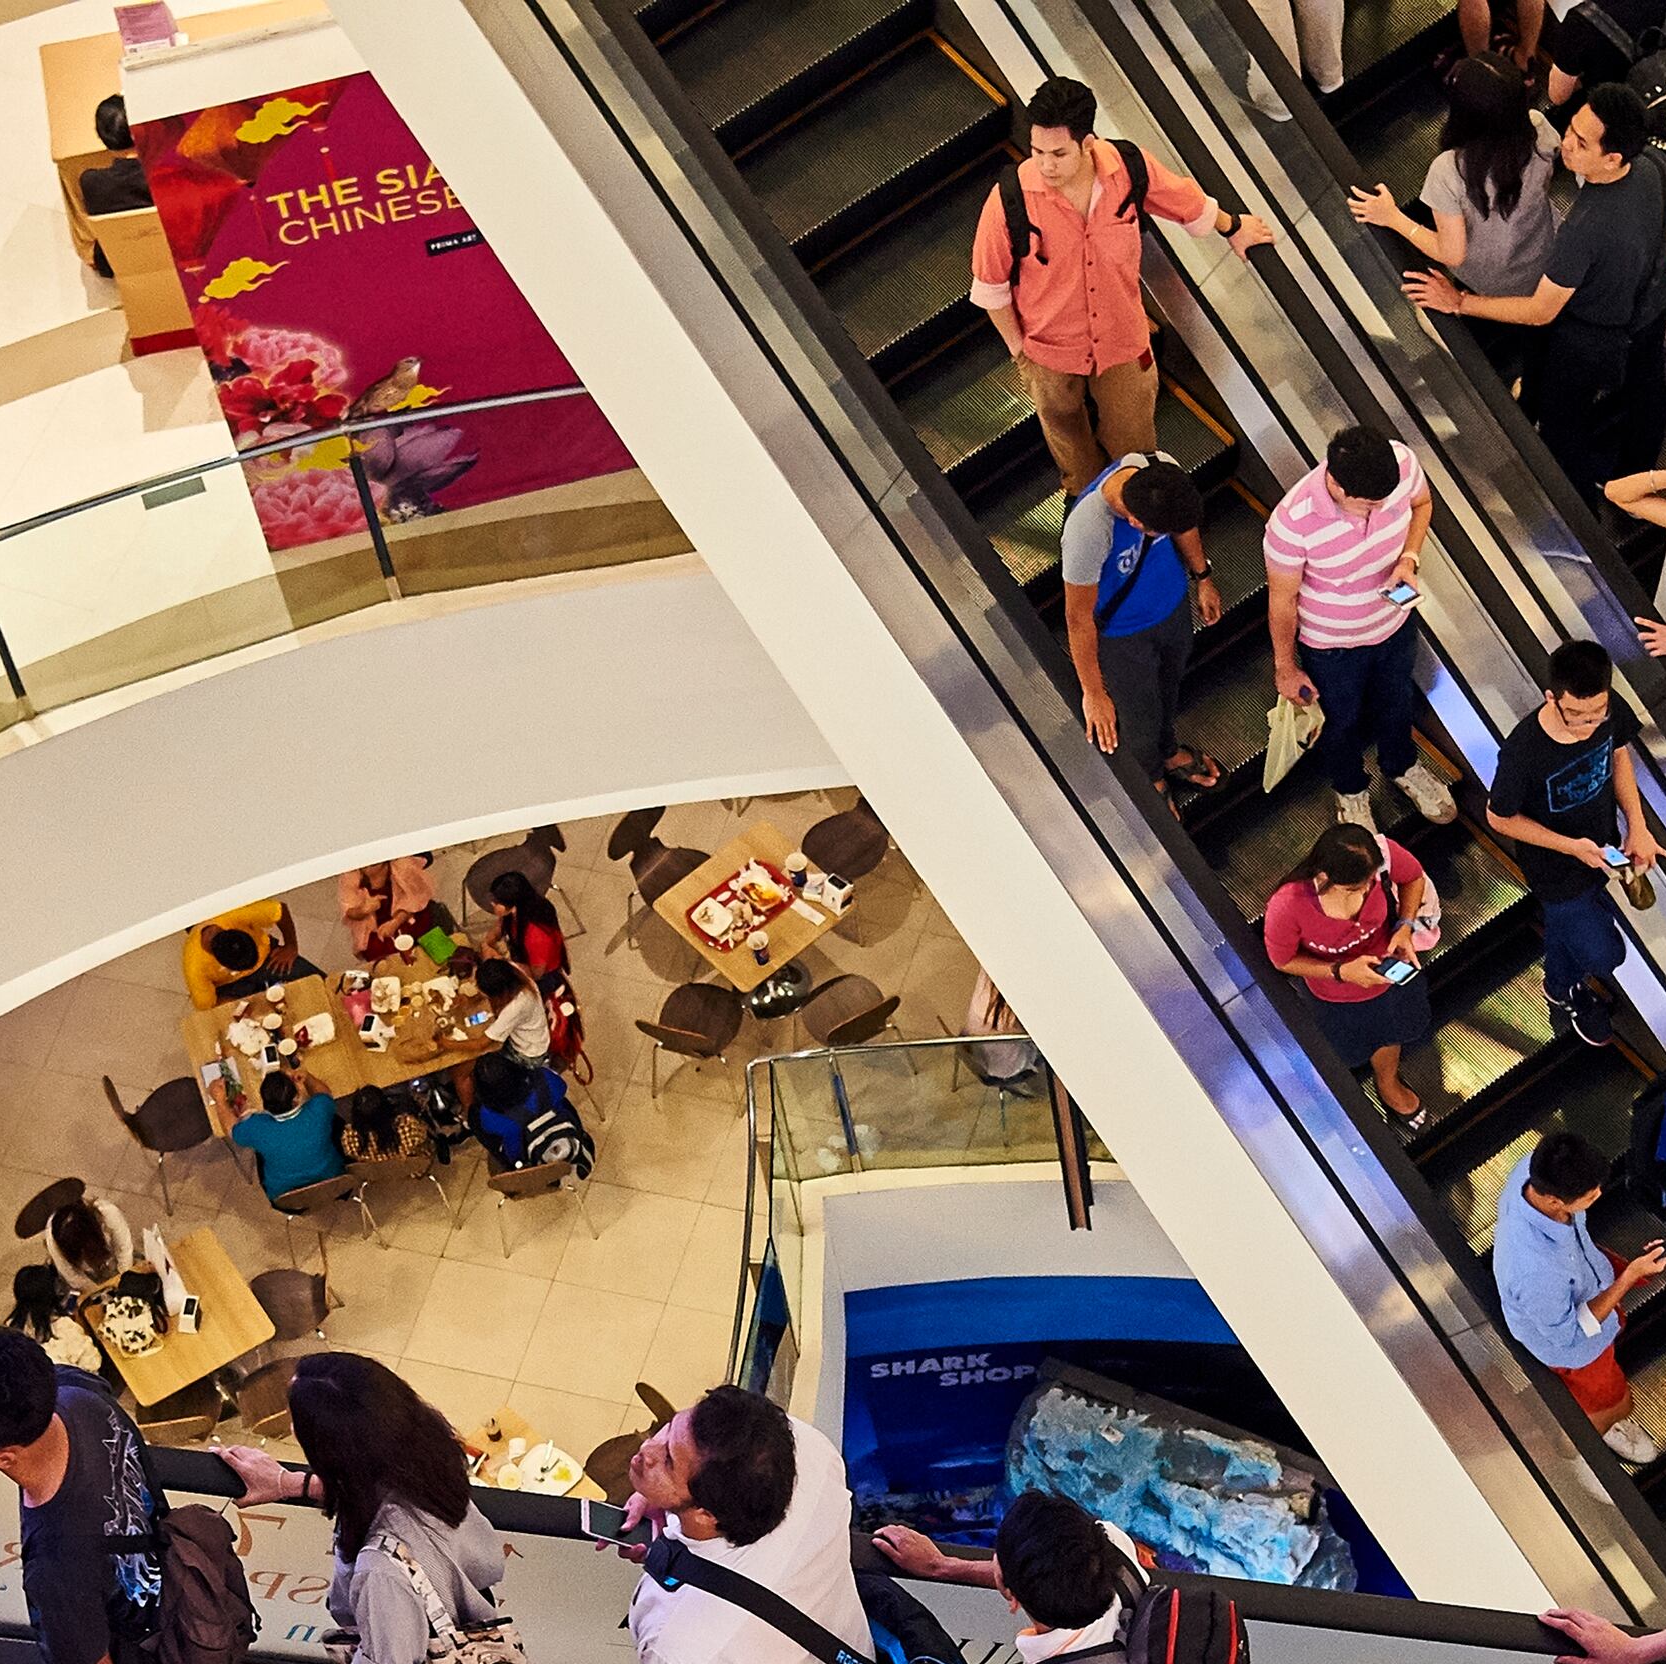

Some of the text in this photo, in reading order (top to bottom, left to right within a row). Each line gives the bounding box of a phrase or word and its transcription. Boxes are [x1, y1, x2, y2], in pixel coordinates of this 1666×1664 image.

[265, 176, 364, 219] THE
[870, 1352, 993, 1379] SHARK
[938, 1364, 1037, 1387] SHOP
